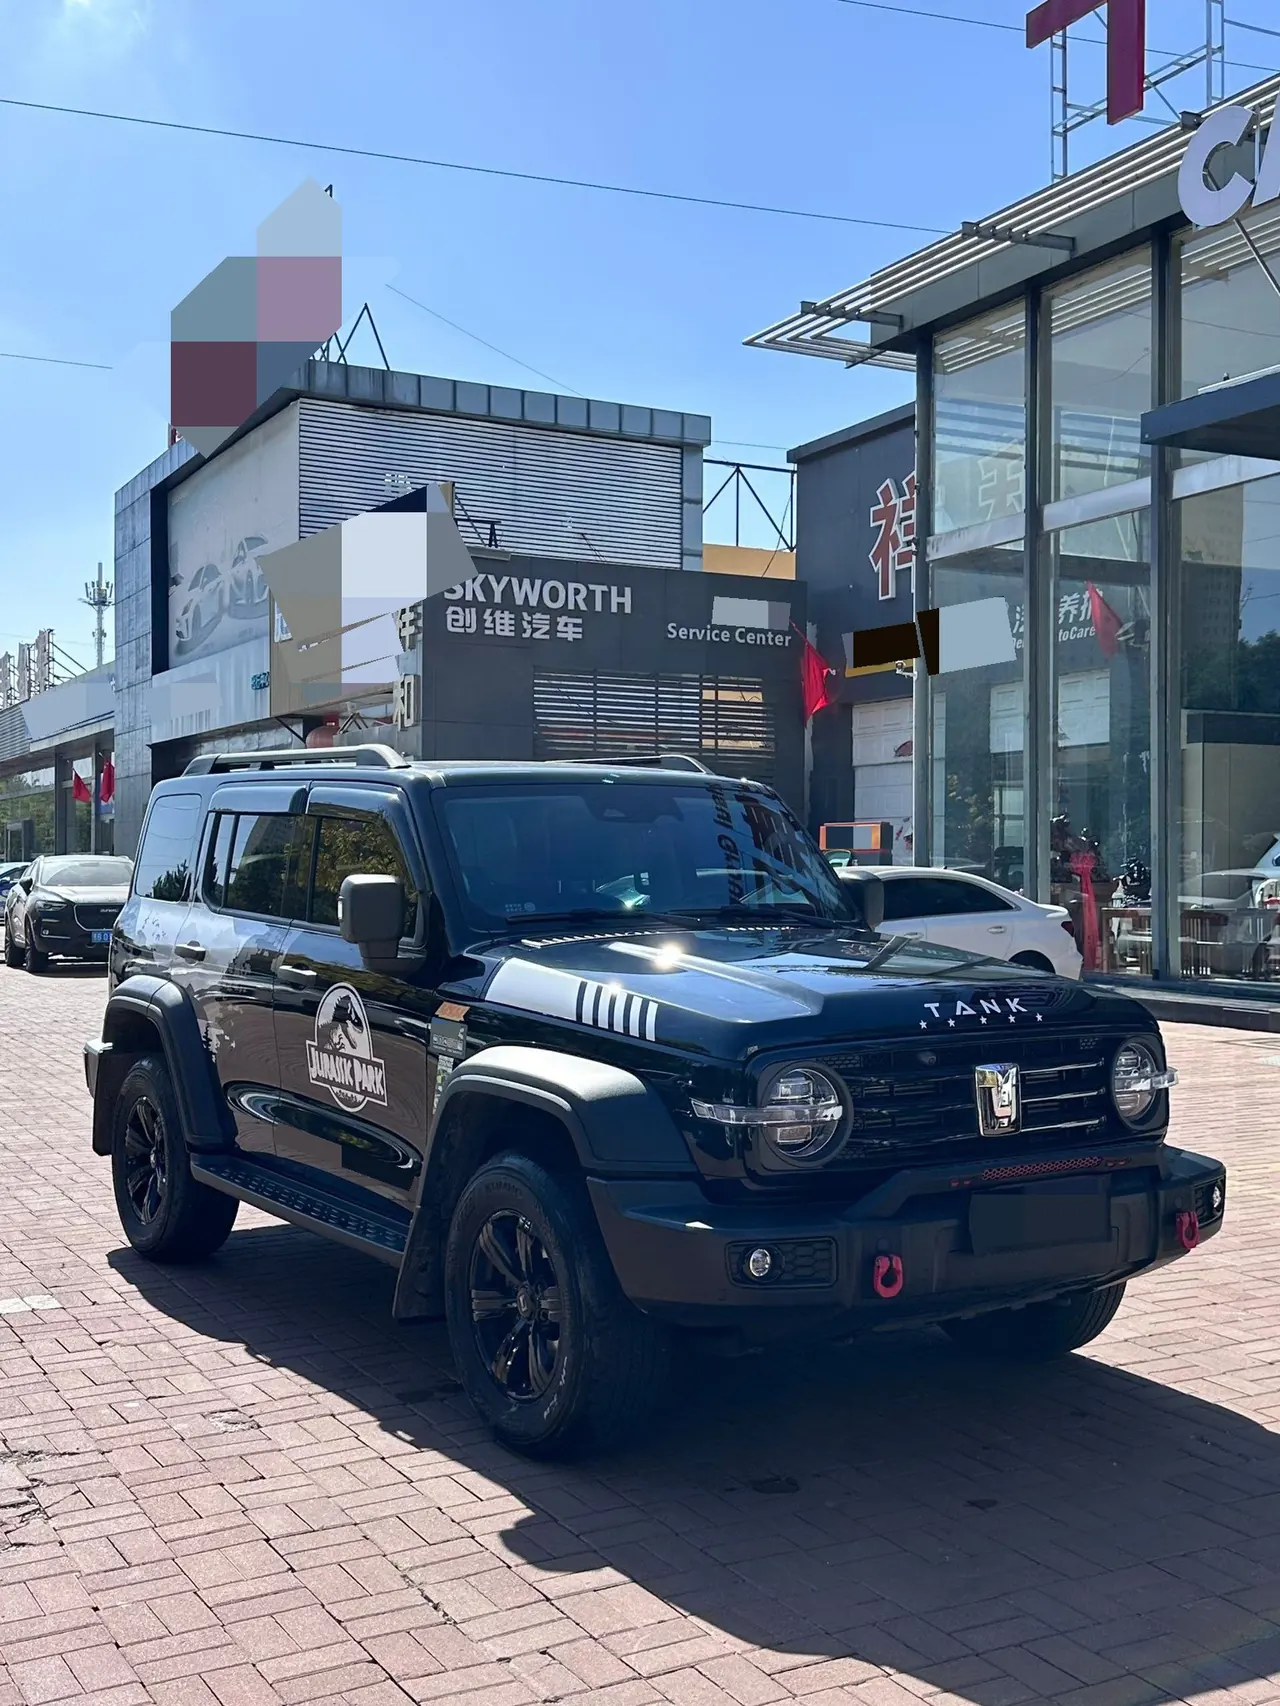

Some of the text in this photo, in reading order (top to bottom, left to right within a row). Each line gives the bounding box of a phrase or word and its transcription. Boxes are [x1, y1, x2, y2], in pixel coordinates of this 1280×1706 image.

[444, 573, 632, 614] SKYWORTH
[445, 605, 583, 642] 创维汽车
[667, 622, 791, 646] Service Center
[924, 998, 1028, 1018] TANK
[353, 1058, 385, 1096] PARK
